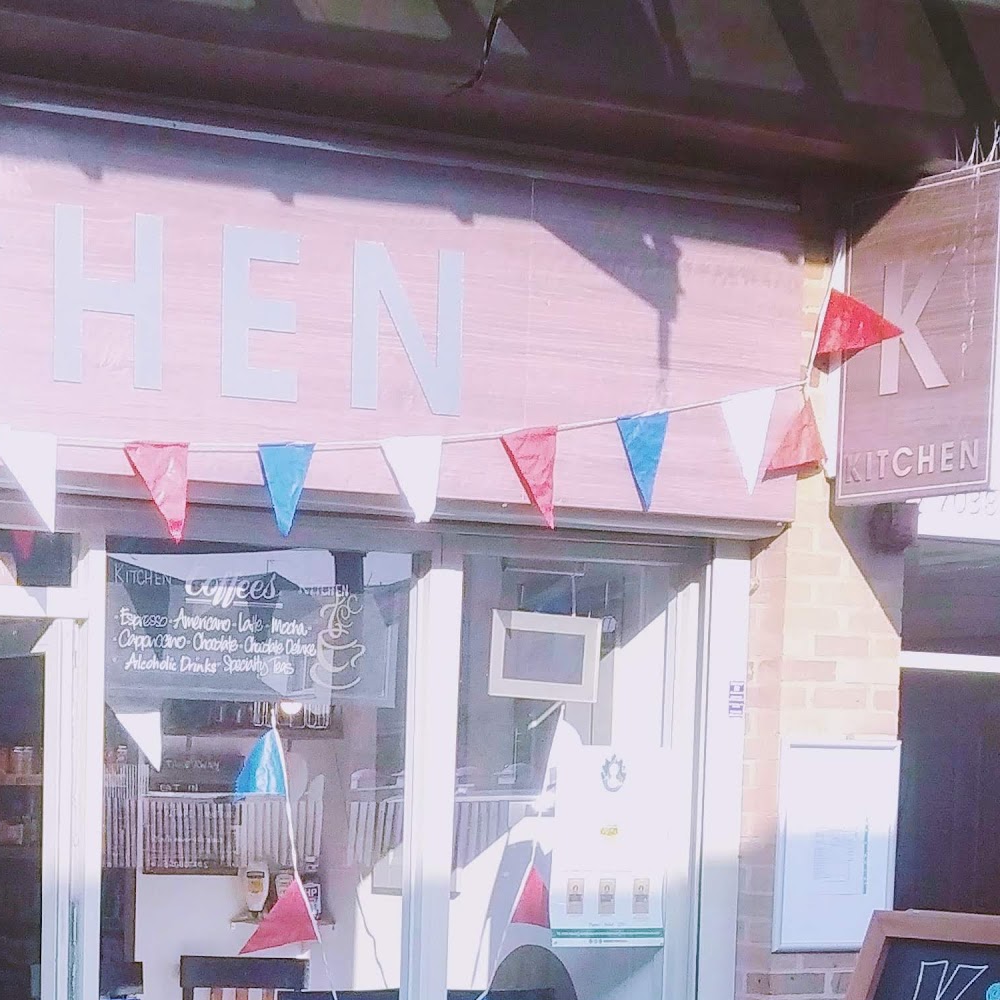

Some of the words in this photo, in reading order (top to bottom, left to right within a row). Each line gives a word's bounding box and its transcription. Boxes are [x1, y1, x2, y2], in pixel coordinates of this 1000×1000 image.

[879, 247, 956, 396] K
[844, 437, 980, 485] KITCHEN
[119, 606, 168, 630] Espresso
[173, 606, 231, 632] Americano
[238, 611, 264, 634] Latte
[271, 616, 308, 637] Mocha
[117, 627, 187, 651] Cappuccino
[192, 631, 238, 653] Chocolate
[124, 651, 177, 671] Alcoholic
[180, 655, 217, 674] Drinks
[269, 656, 295, 675] Teas
[304, 888, 318, 897] HP
